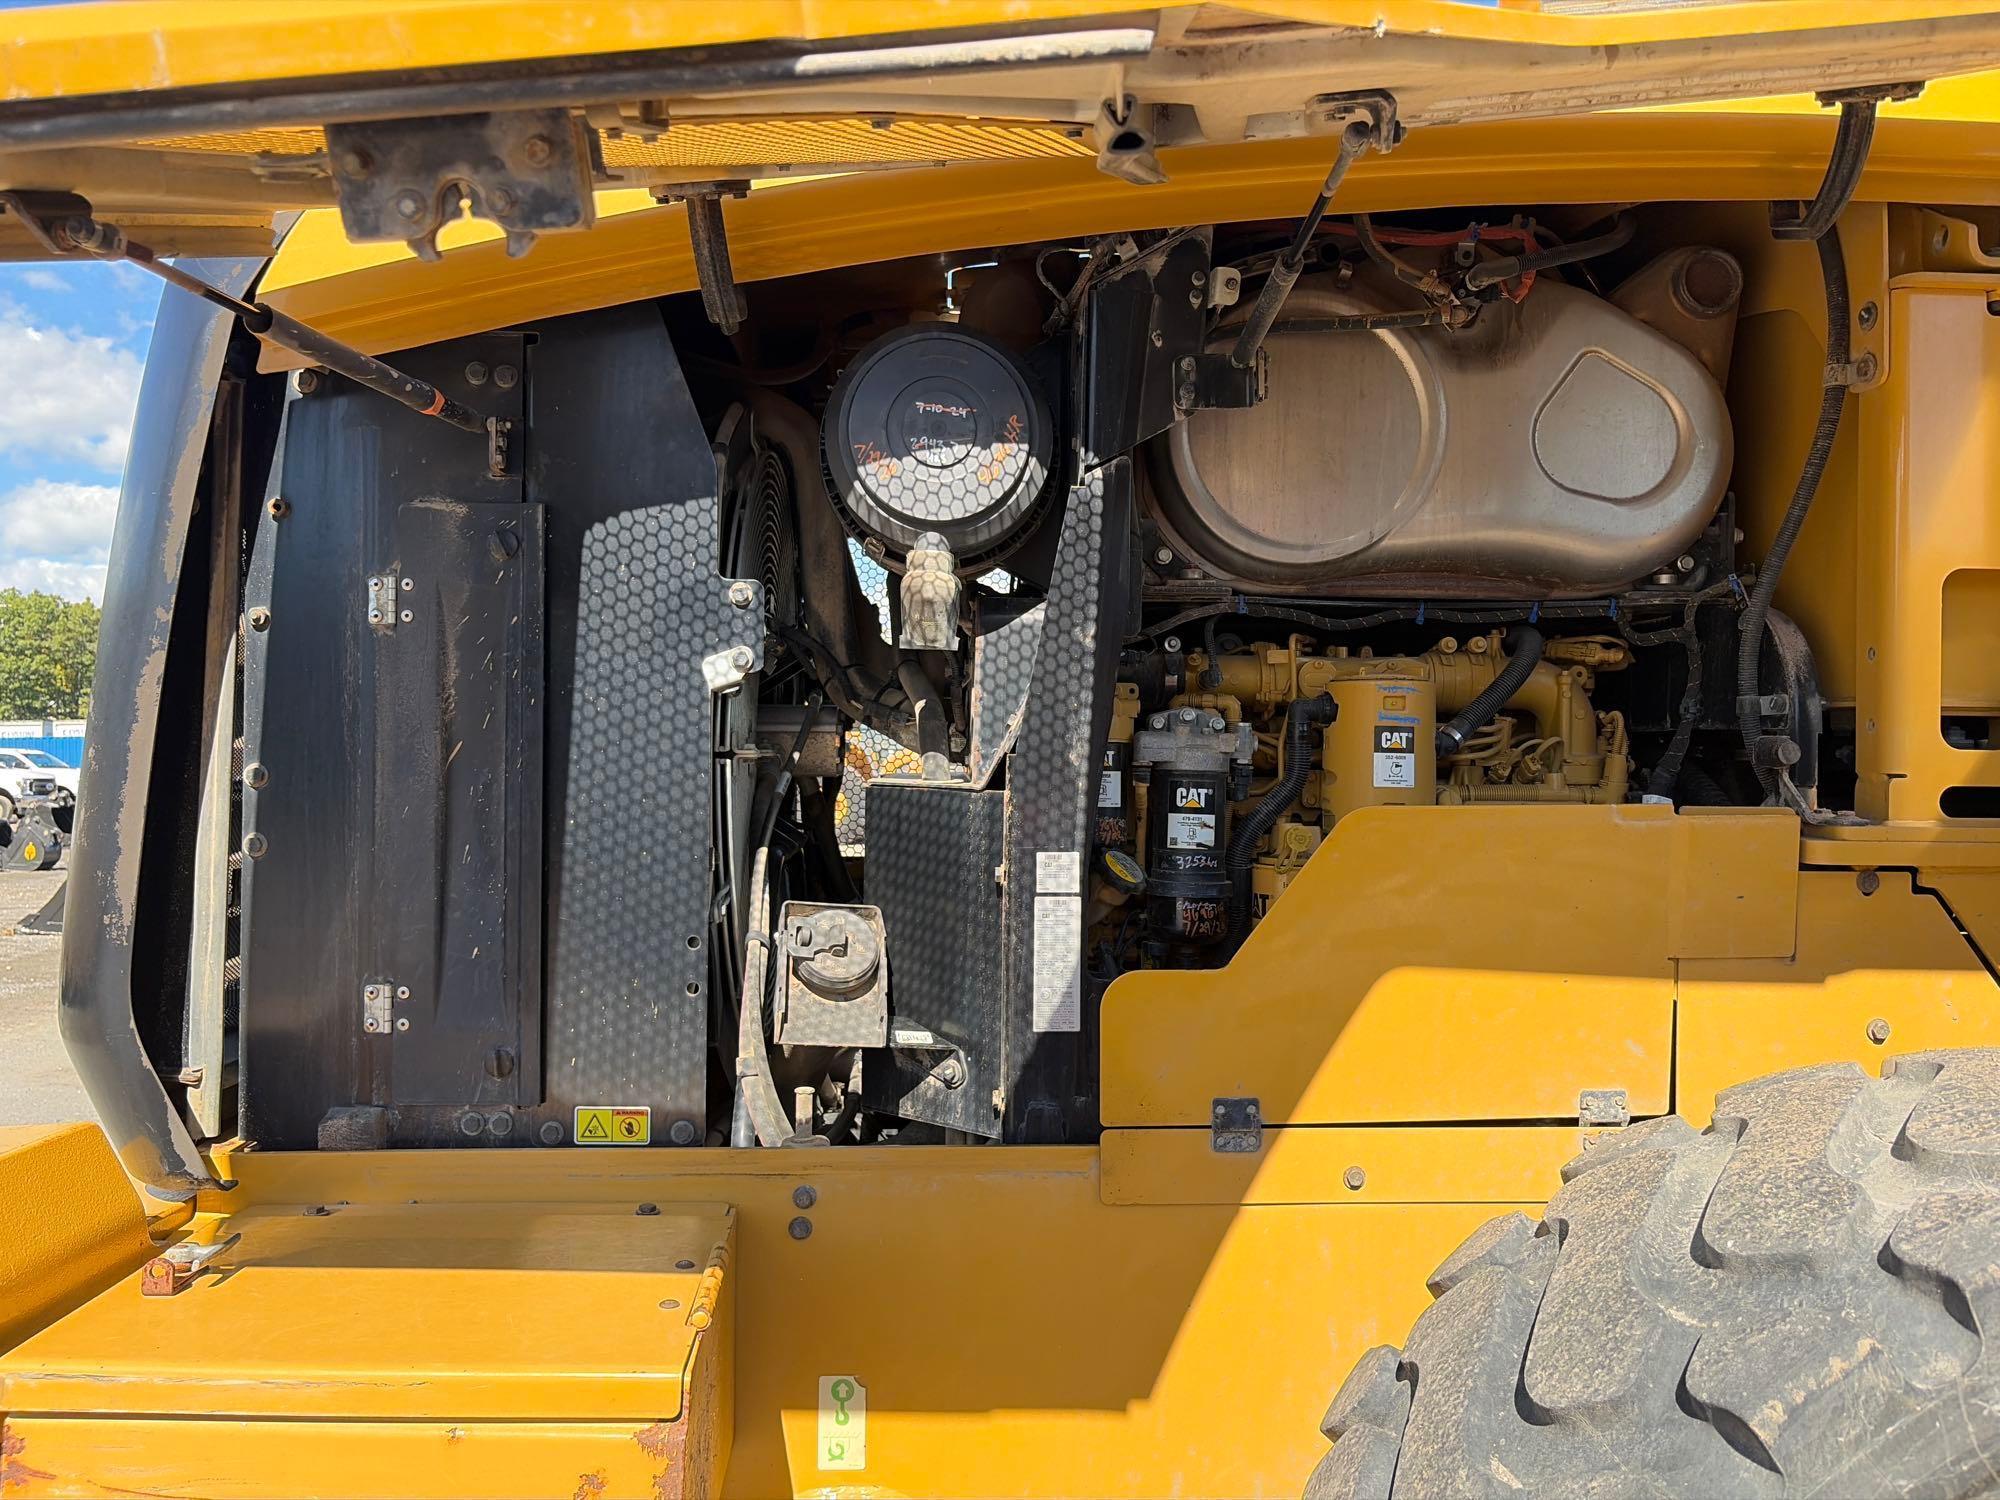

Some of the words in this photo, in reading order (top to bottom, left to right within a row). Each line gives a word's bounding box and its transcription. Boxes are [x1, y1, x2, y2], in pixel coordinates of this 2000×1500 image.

[1381, 731, 1409, 749] CAT
[1176, 787, 1208, 808] CAT
[1252, 893, 1269, 919] AT
